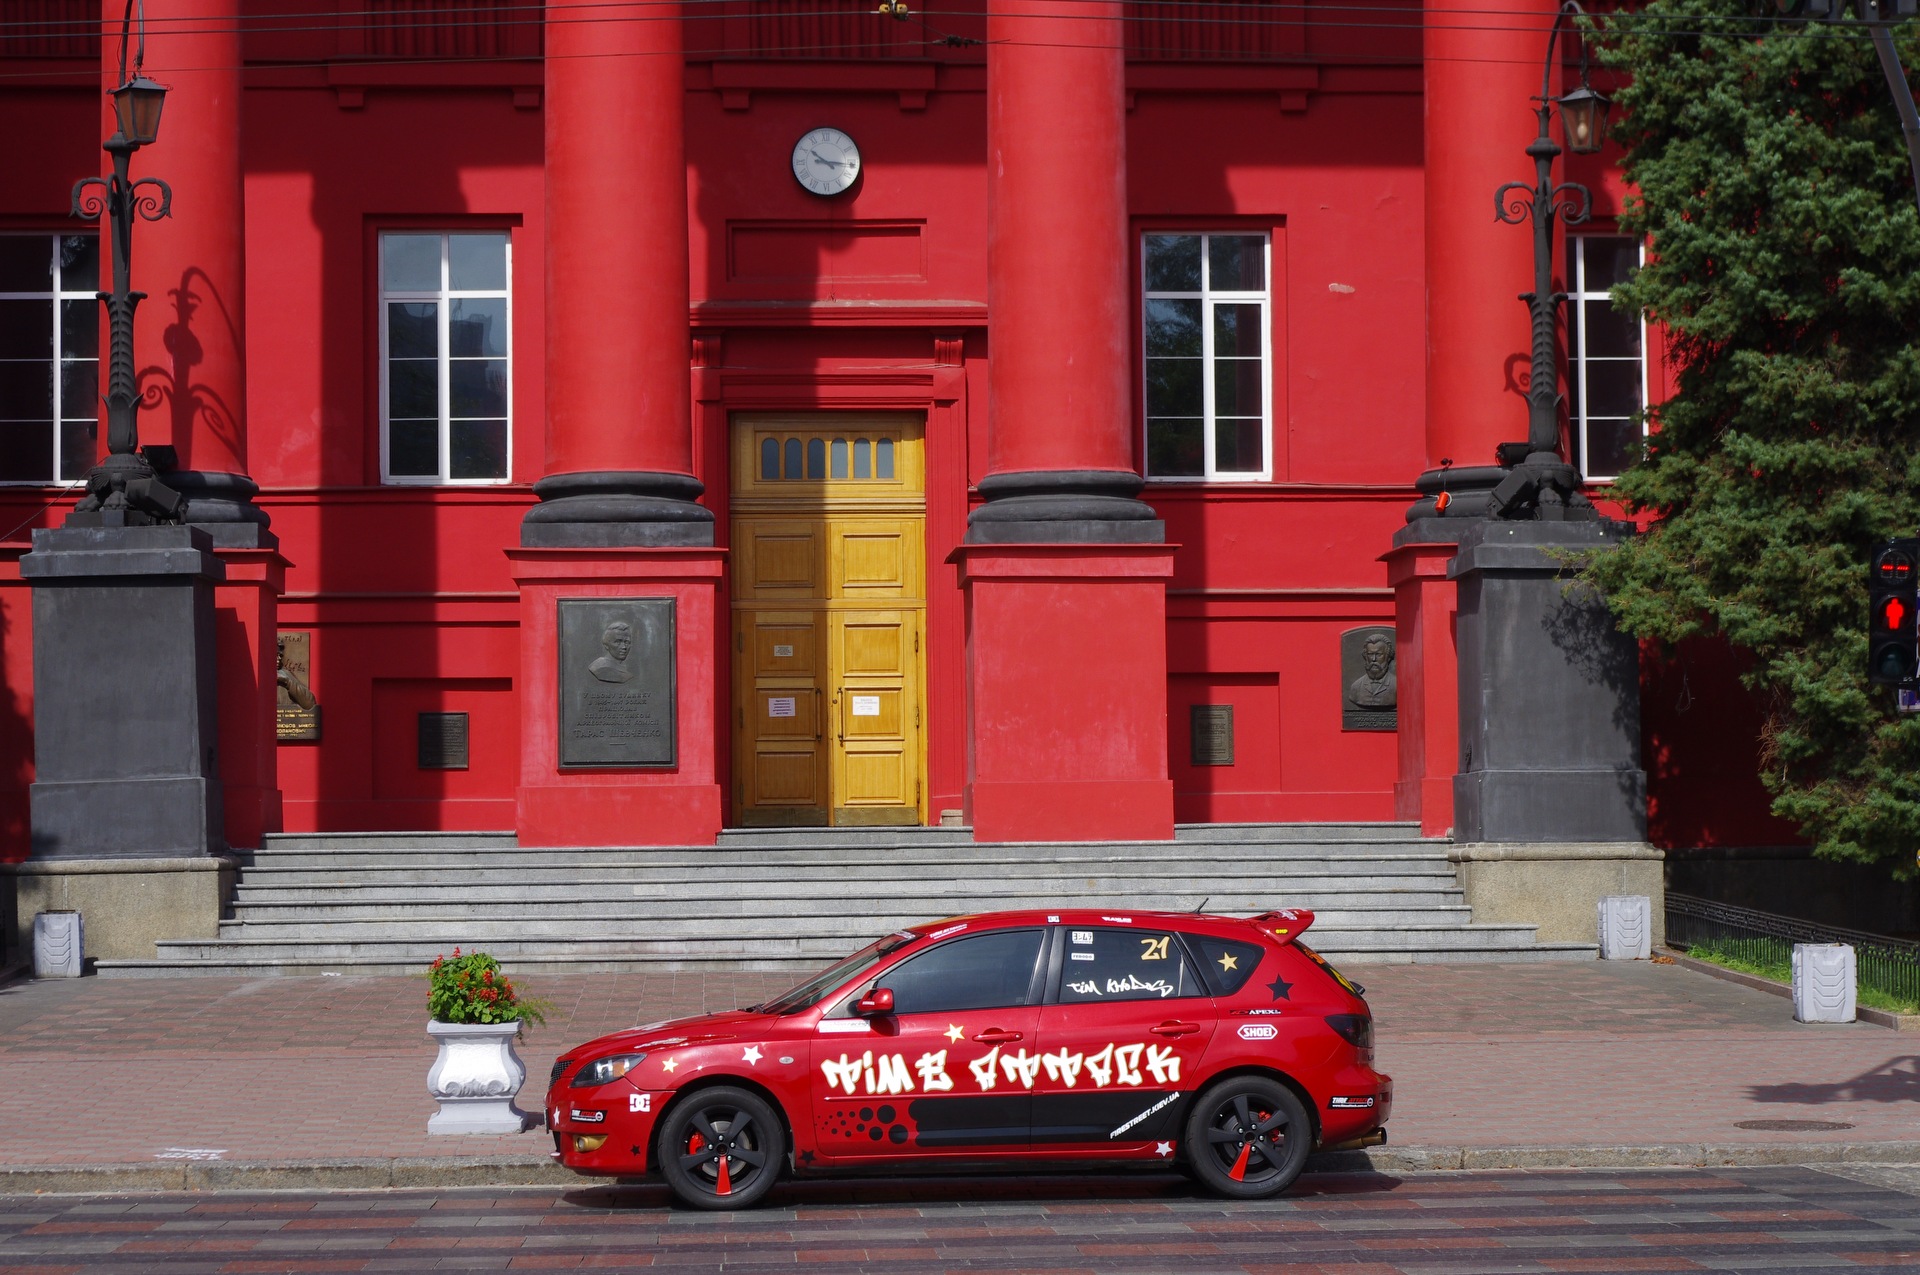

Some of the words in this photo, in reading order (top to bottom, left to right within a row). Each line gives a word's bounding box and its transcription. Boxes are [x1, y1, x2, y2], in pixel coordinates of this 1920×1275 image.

[1140, 936, 1170, 960] 21
[1243, 1027, 1272, 1037] SHOEI
[968, 1043, 1181, 1091] ATTACK
[1109, 1091, 1180, 1139] FIRESTREET.KIEV.UA
